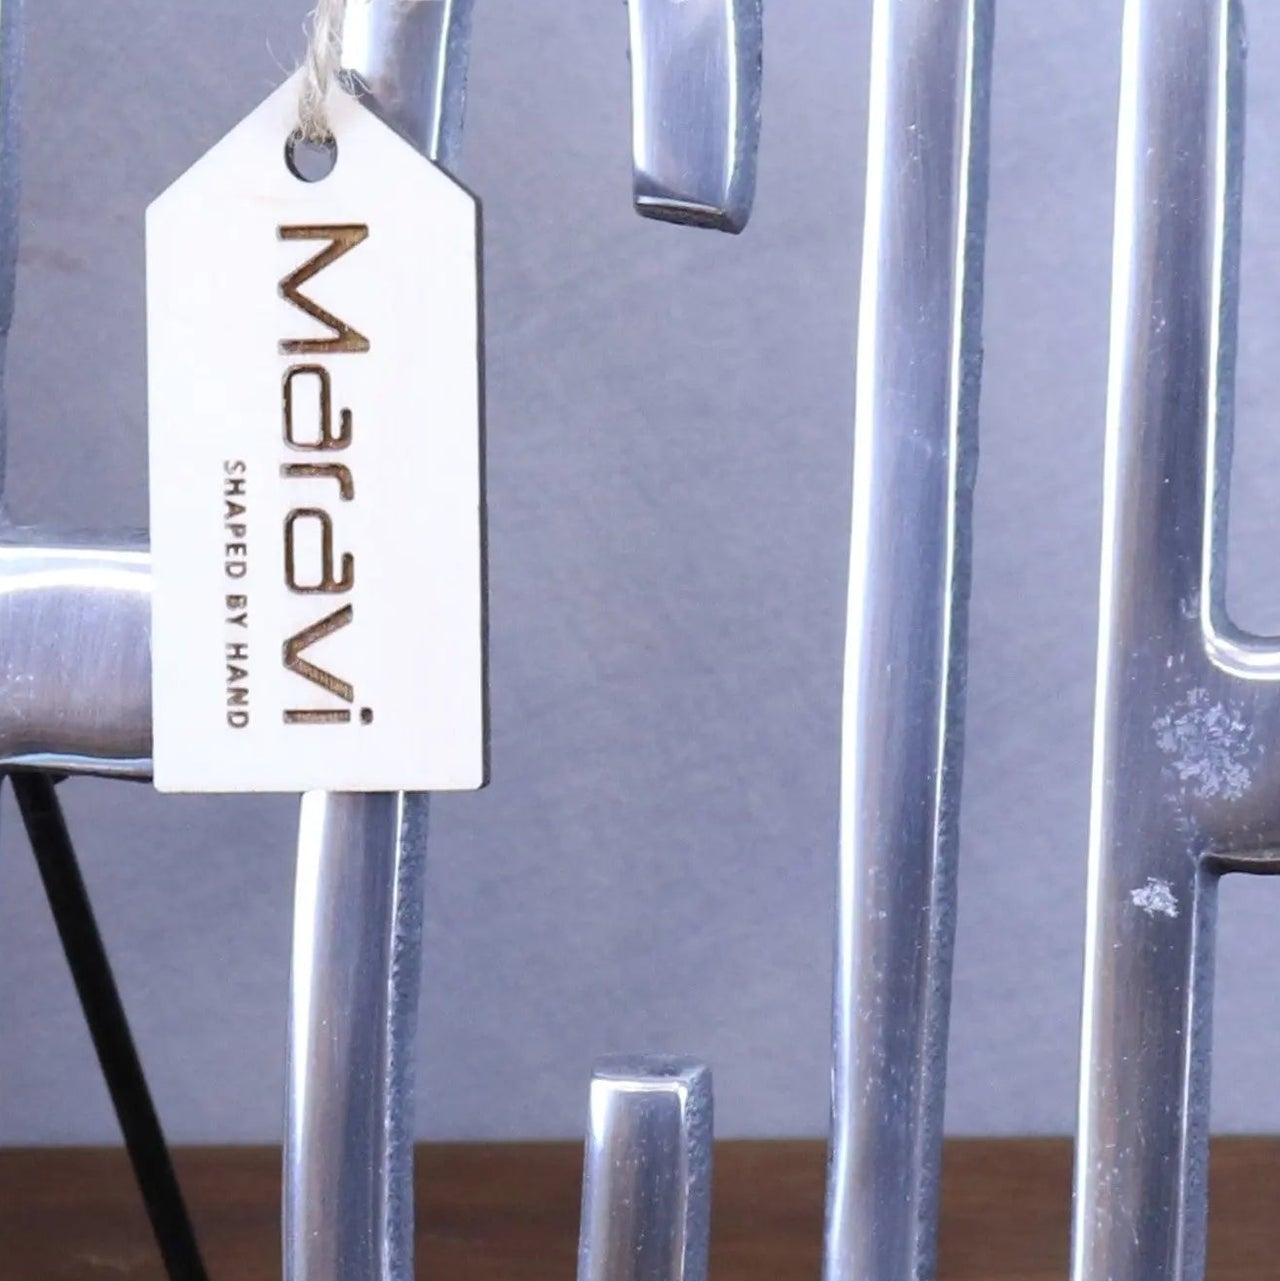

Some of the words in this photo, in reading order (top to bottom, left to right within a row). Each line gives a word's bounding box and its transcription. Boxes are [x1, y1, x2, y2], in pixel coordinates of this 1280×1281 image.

[223, 459, 248, 580] SHAPED
[277, 222, 374, 726] Maravi
[224, 593, 249, 629] BY
[225, 642, 251, 730] HAND
